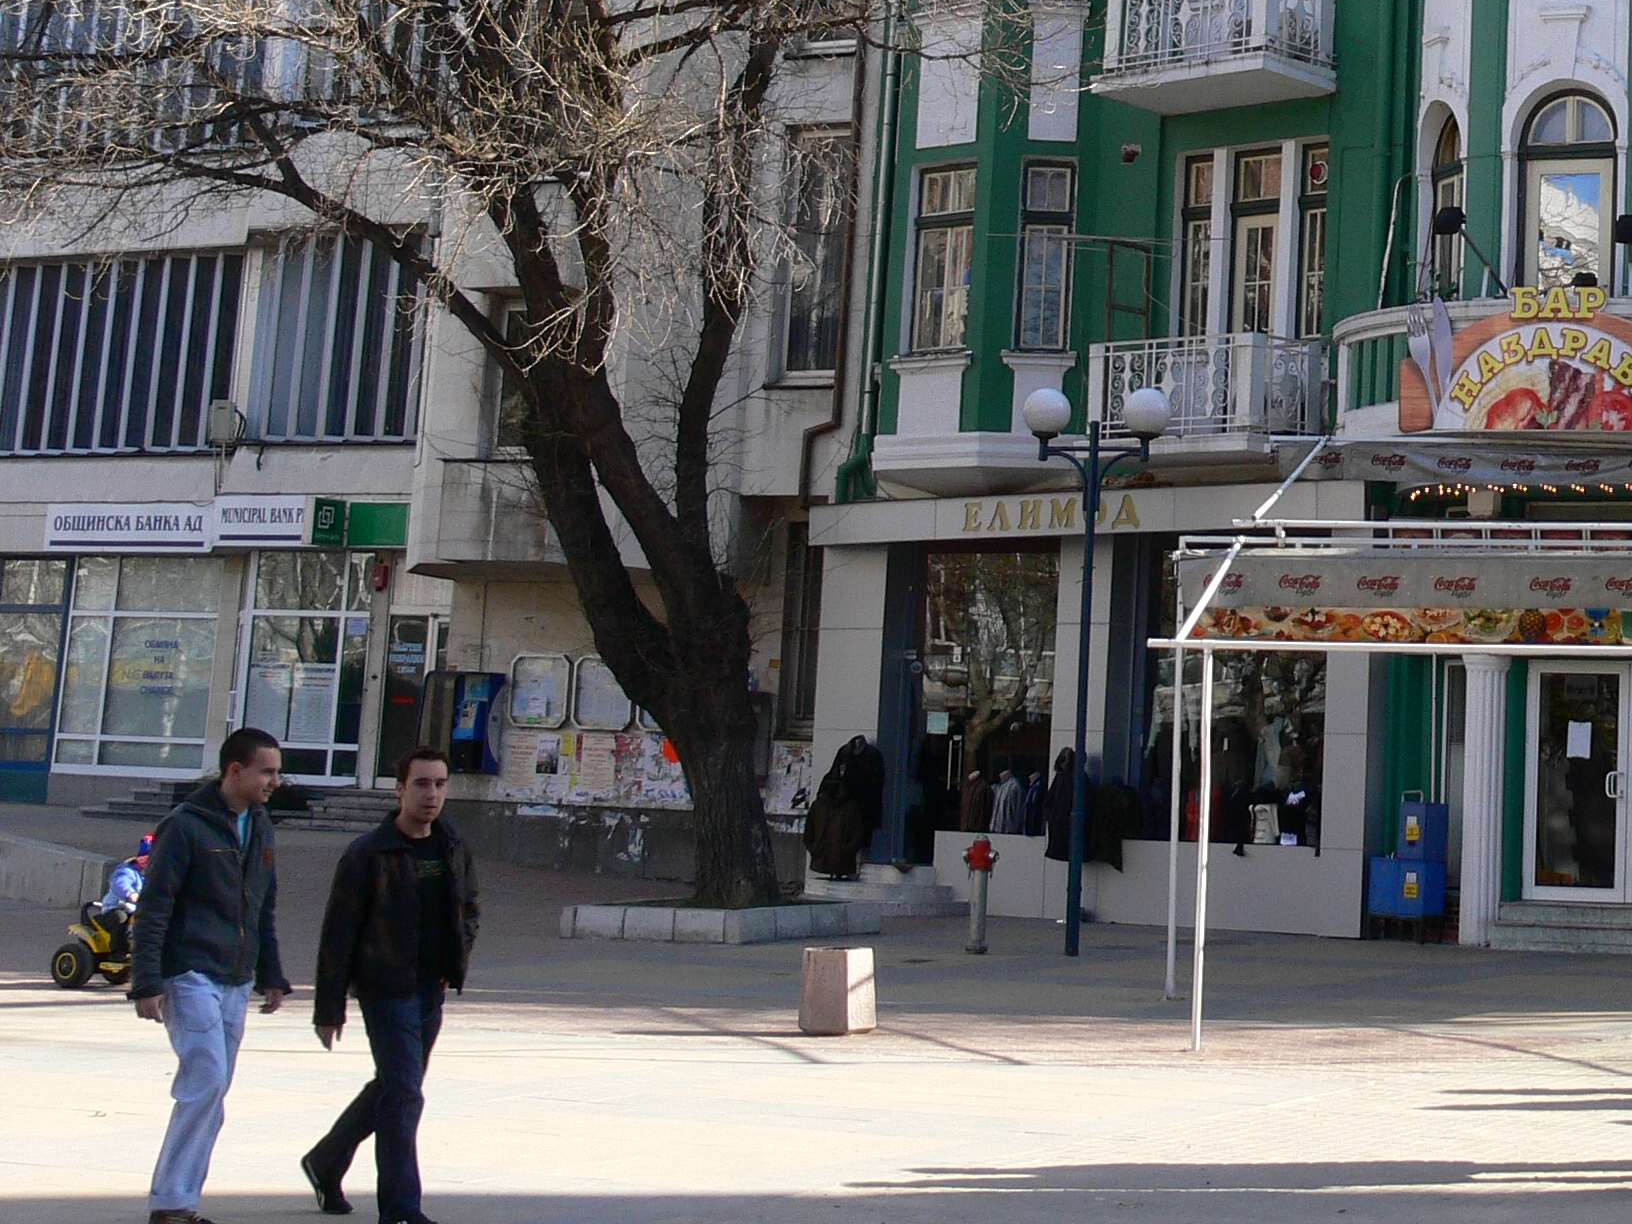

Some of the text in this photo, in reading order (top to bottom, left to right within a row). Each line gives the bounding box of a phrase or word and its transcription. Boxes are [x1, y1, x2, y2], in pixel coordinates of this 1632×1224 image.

[1510, 286, 1607, 320] БАР
[53, 514, 204, 534] ОБЩИНСКА БАНКА АД
[221, 507, 268, 524] MUNICIPAL
[270, 507, 295, 523] BANK
[1278, 574, 1322, 590] Coca-Cola
[1356, 575, 1400, 591] Coca-Cola
[1434, 575, 1478, 592] Coca-Cola
[1529, 576, 1573, 592] Coca-Cola
